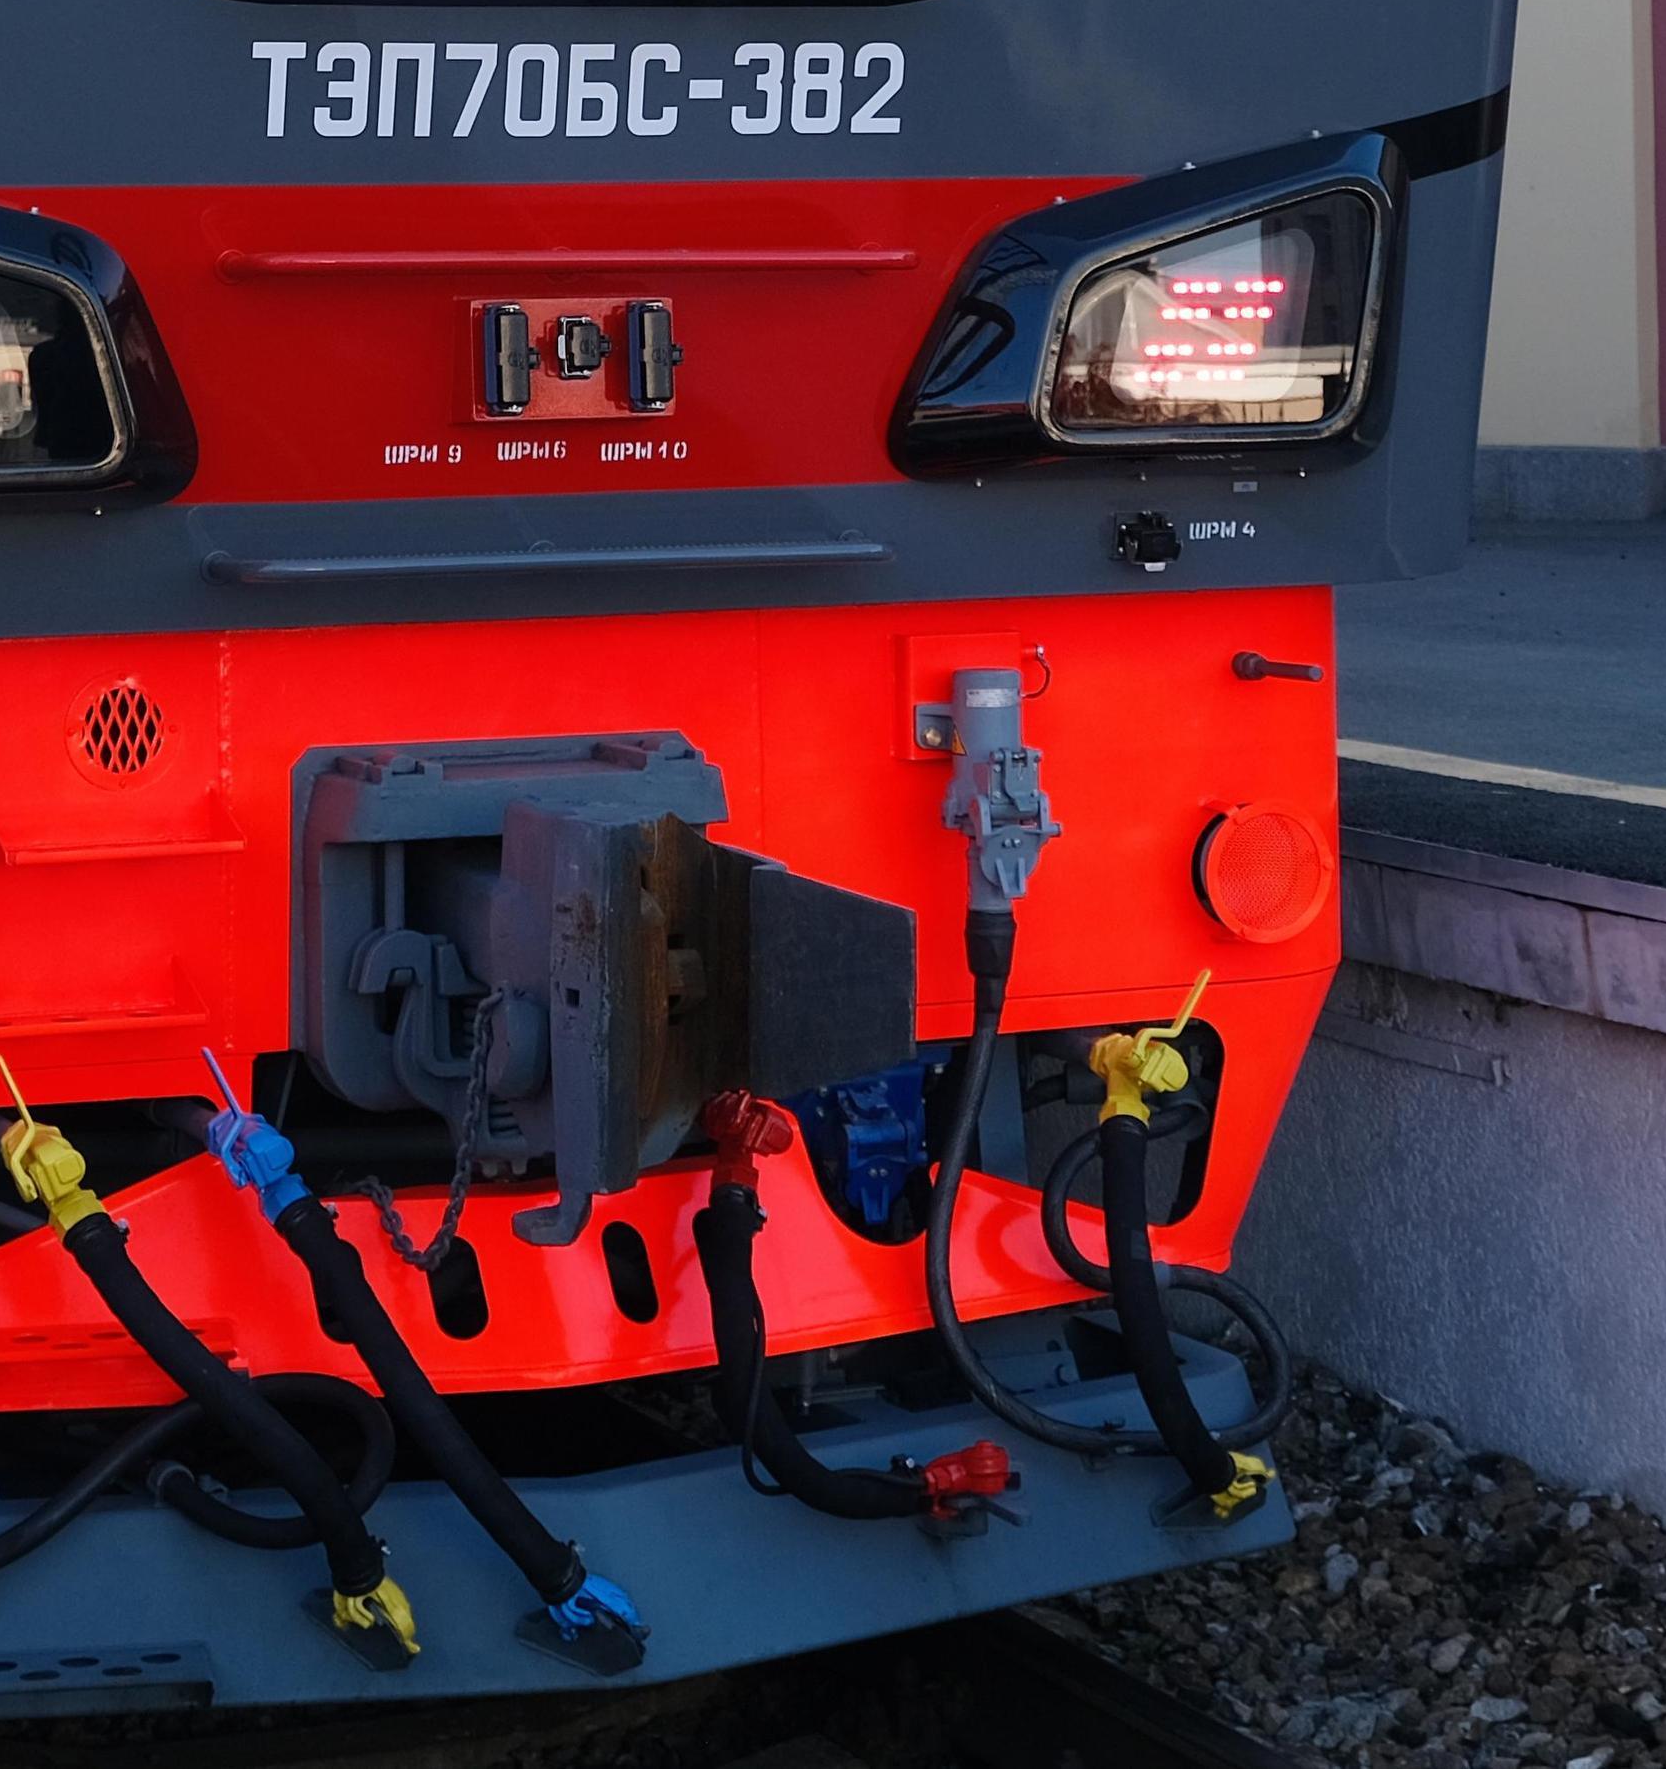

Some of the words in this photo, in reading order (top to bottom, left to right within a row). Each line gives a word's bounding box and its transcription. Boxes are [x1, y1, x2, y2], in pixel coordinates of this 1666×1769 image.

[252, 41, 905, 137] ТЭП70БС-382
[384, 444, 438, 465] ШРМ
[447, 444, 462, 464] 9
[600, 442, 653, 462] ШРМ
[1189, 520, 1237, 540] ШРМ
[1242, 521, 1256, 538] 4
